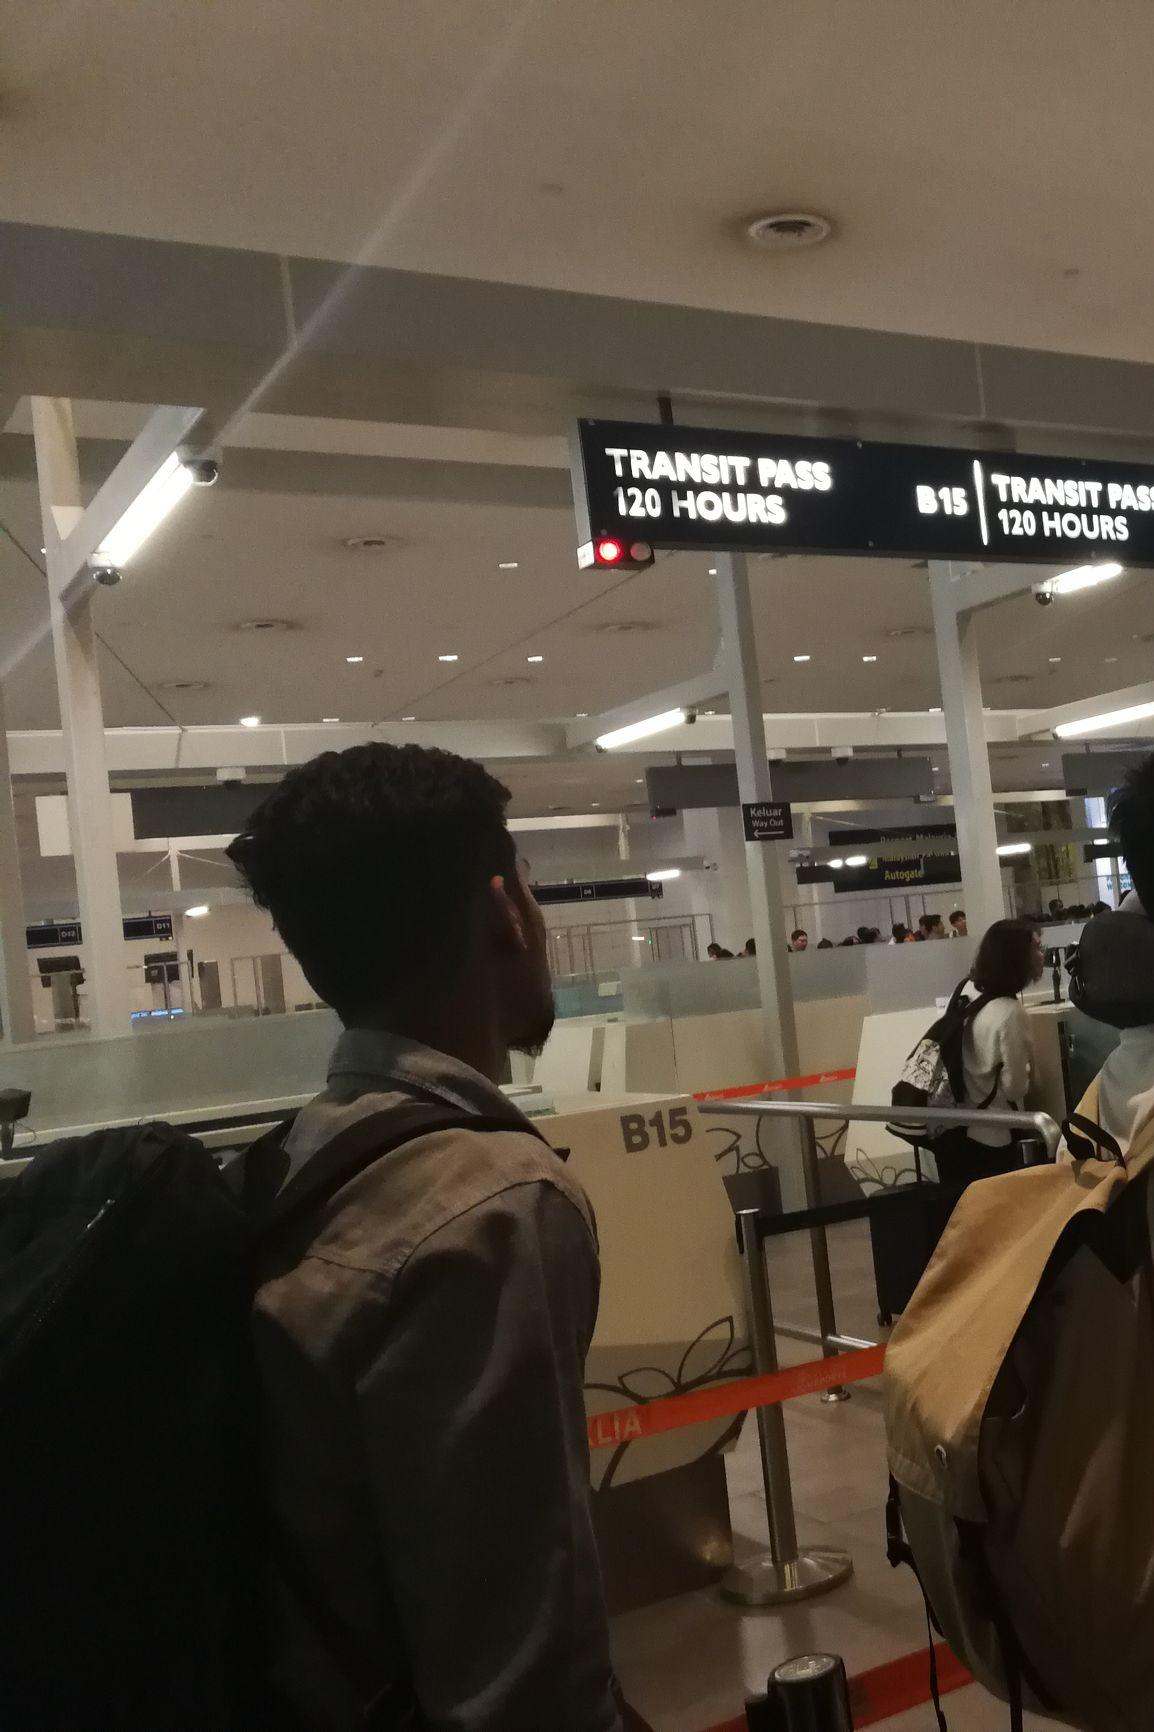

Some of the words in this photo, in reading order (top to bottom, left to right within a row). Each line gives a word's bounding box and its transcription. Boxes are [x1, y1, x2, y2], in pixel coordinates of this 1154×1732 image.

[605, 447, 751, 486] TRANSIT
[757, 457, 833, 491] PASS
[614, 486, 662, 518] 120
[671, 489, 788, 525] HOURS
[915, 484, 968, 516] B15
[991, 473, 1102, 508] TRANSIT
[998, 508, 1036, 536] 120
[1043, 511, 1129, 542] HOURS
[750, 806, 783, 817] Keluar
[751, 819, 768, 829] Way
[769, 817, 784, 827] Out
[620, 1106, 693, 1153] B15
[589, 1409, 643, 1446] LIA
